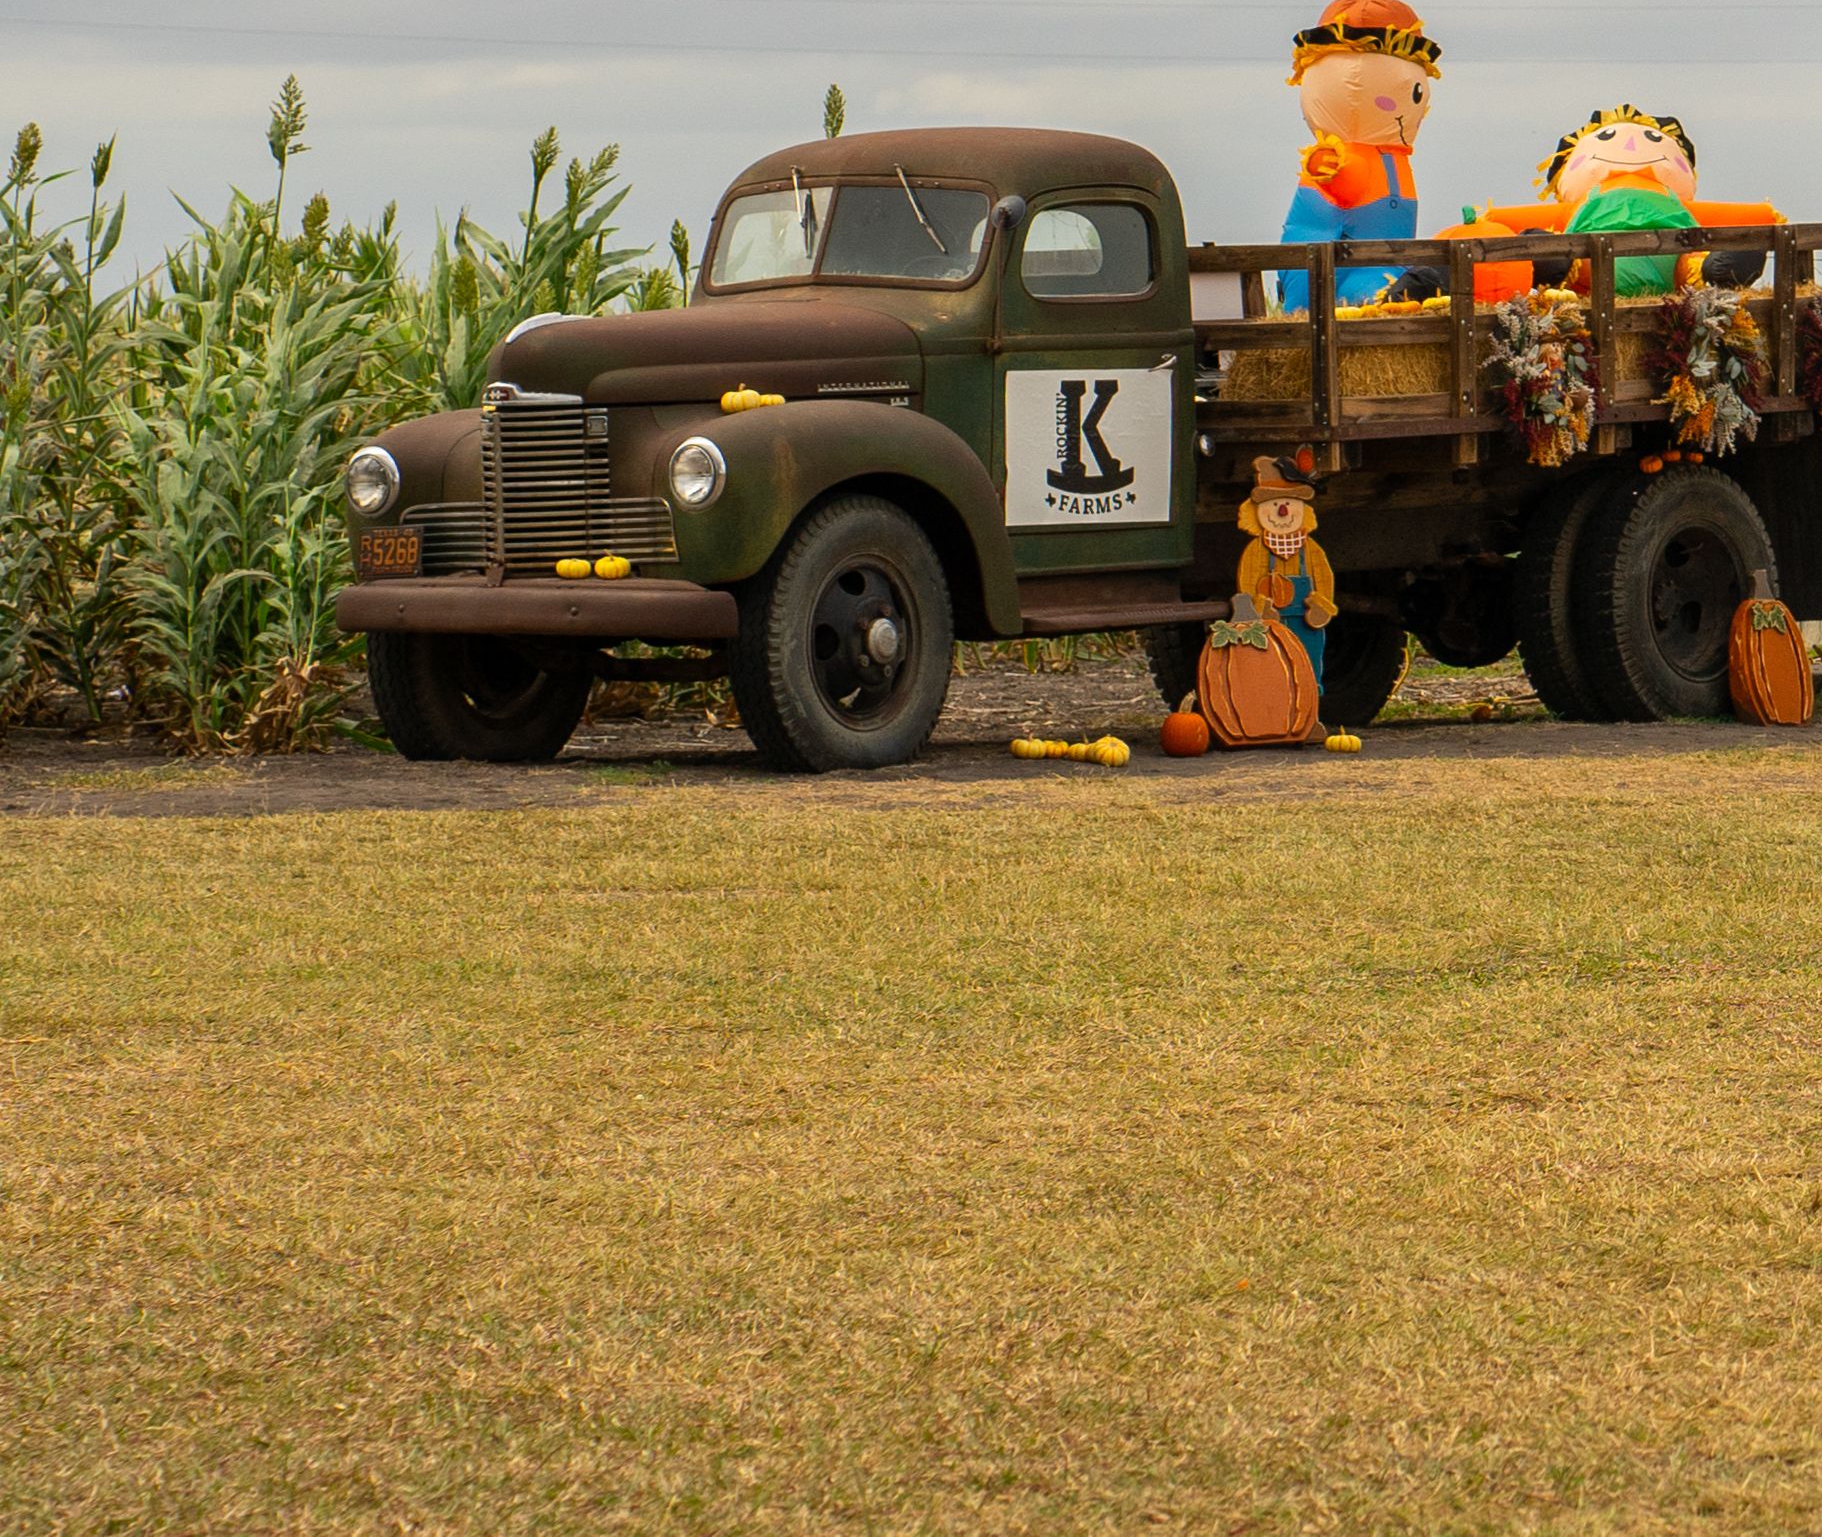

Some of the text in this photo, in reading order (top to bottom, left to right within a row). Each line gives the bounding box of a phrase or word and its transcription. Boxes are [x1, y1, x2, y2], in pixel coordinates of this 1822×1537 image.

[1056, 392, 1067, 459] ROCKIN'
[1060, 379, 1121, 478] K
[1058, 493, 1123, 515] FARMS
[373, 537, 418, 565] 5268
